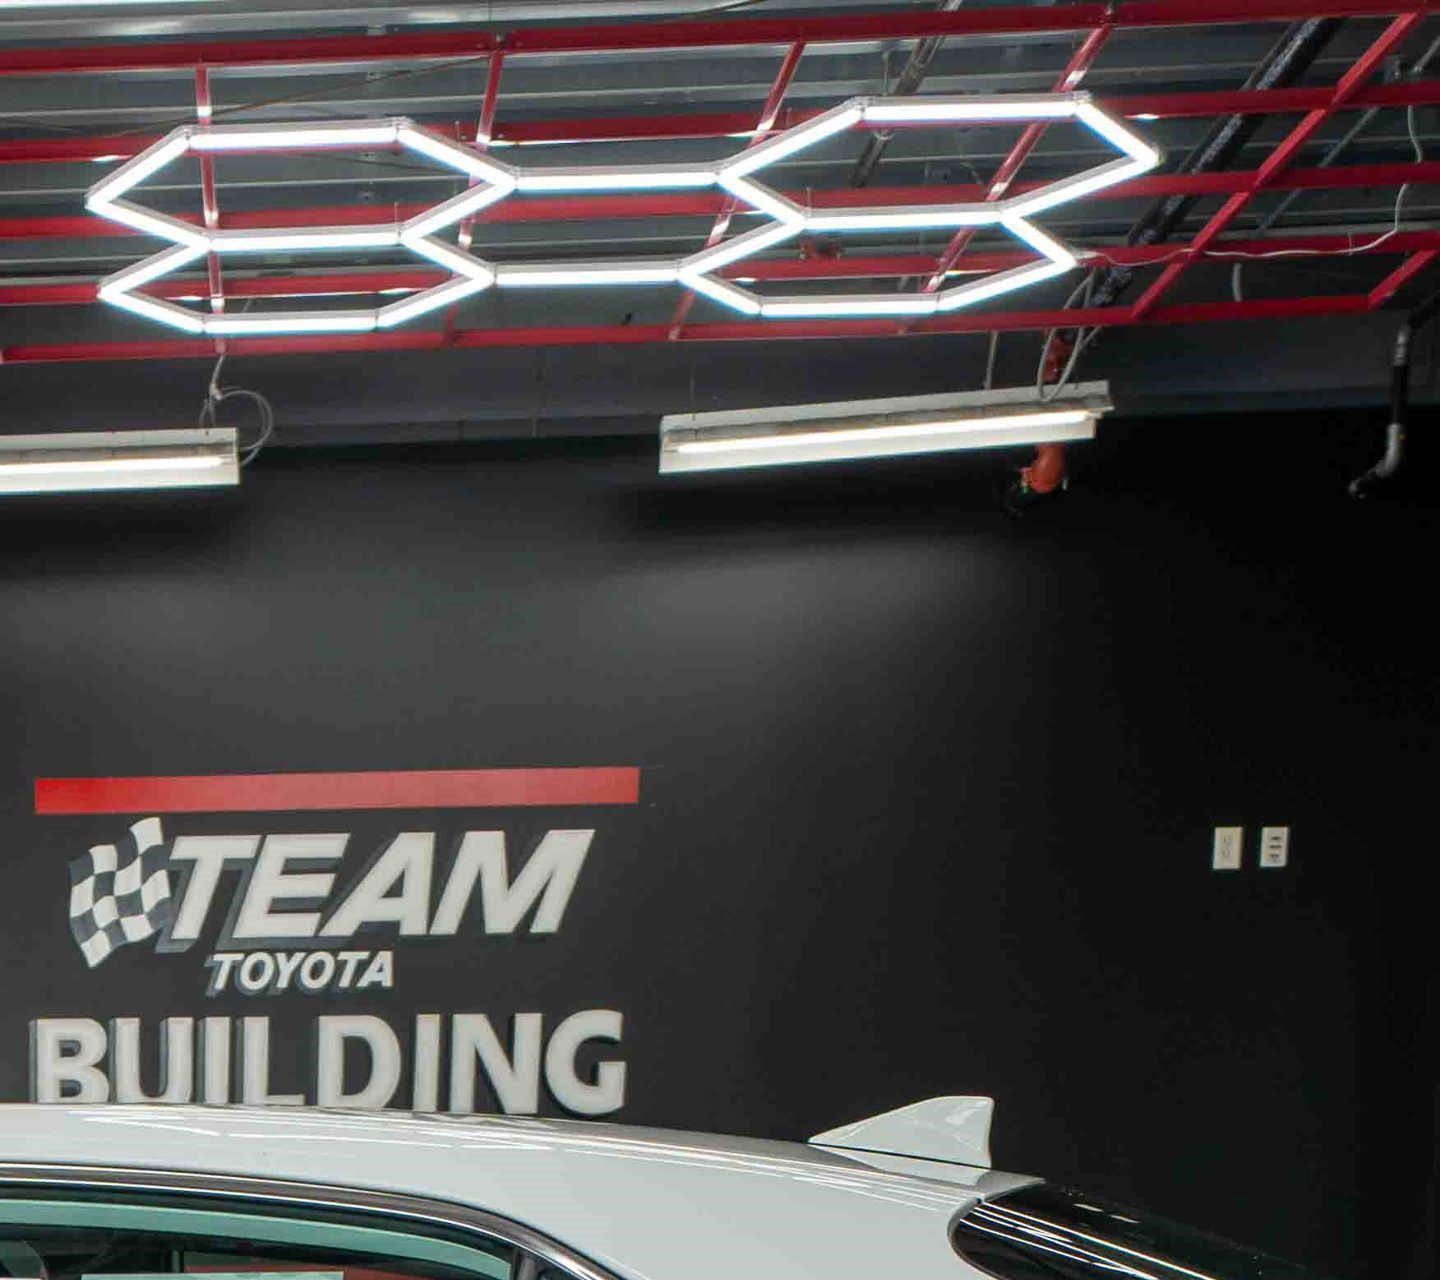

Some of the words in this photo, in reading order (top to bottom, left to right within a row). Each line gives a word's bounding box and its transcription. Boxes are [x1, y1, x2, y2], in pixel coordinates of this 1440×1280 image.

[166, 828, 596, 943] TEAM
[210, 950, 394, 992] TOYOTA
[34, 1009, 626, 1115] BUILDING
